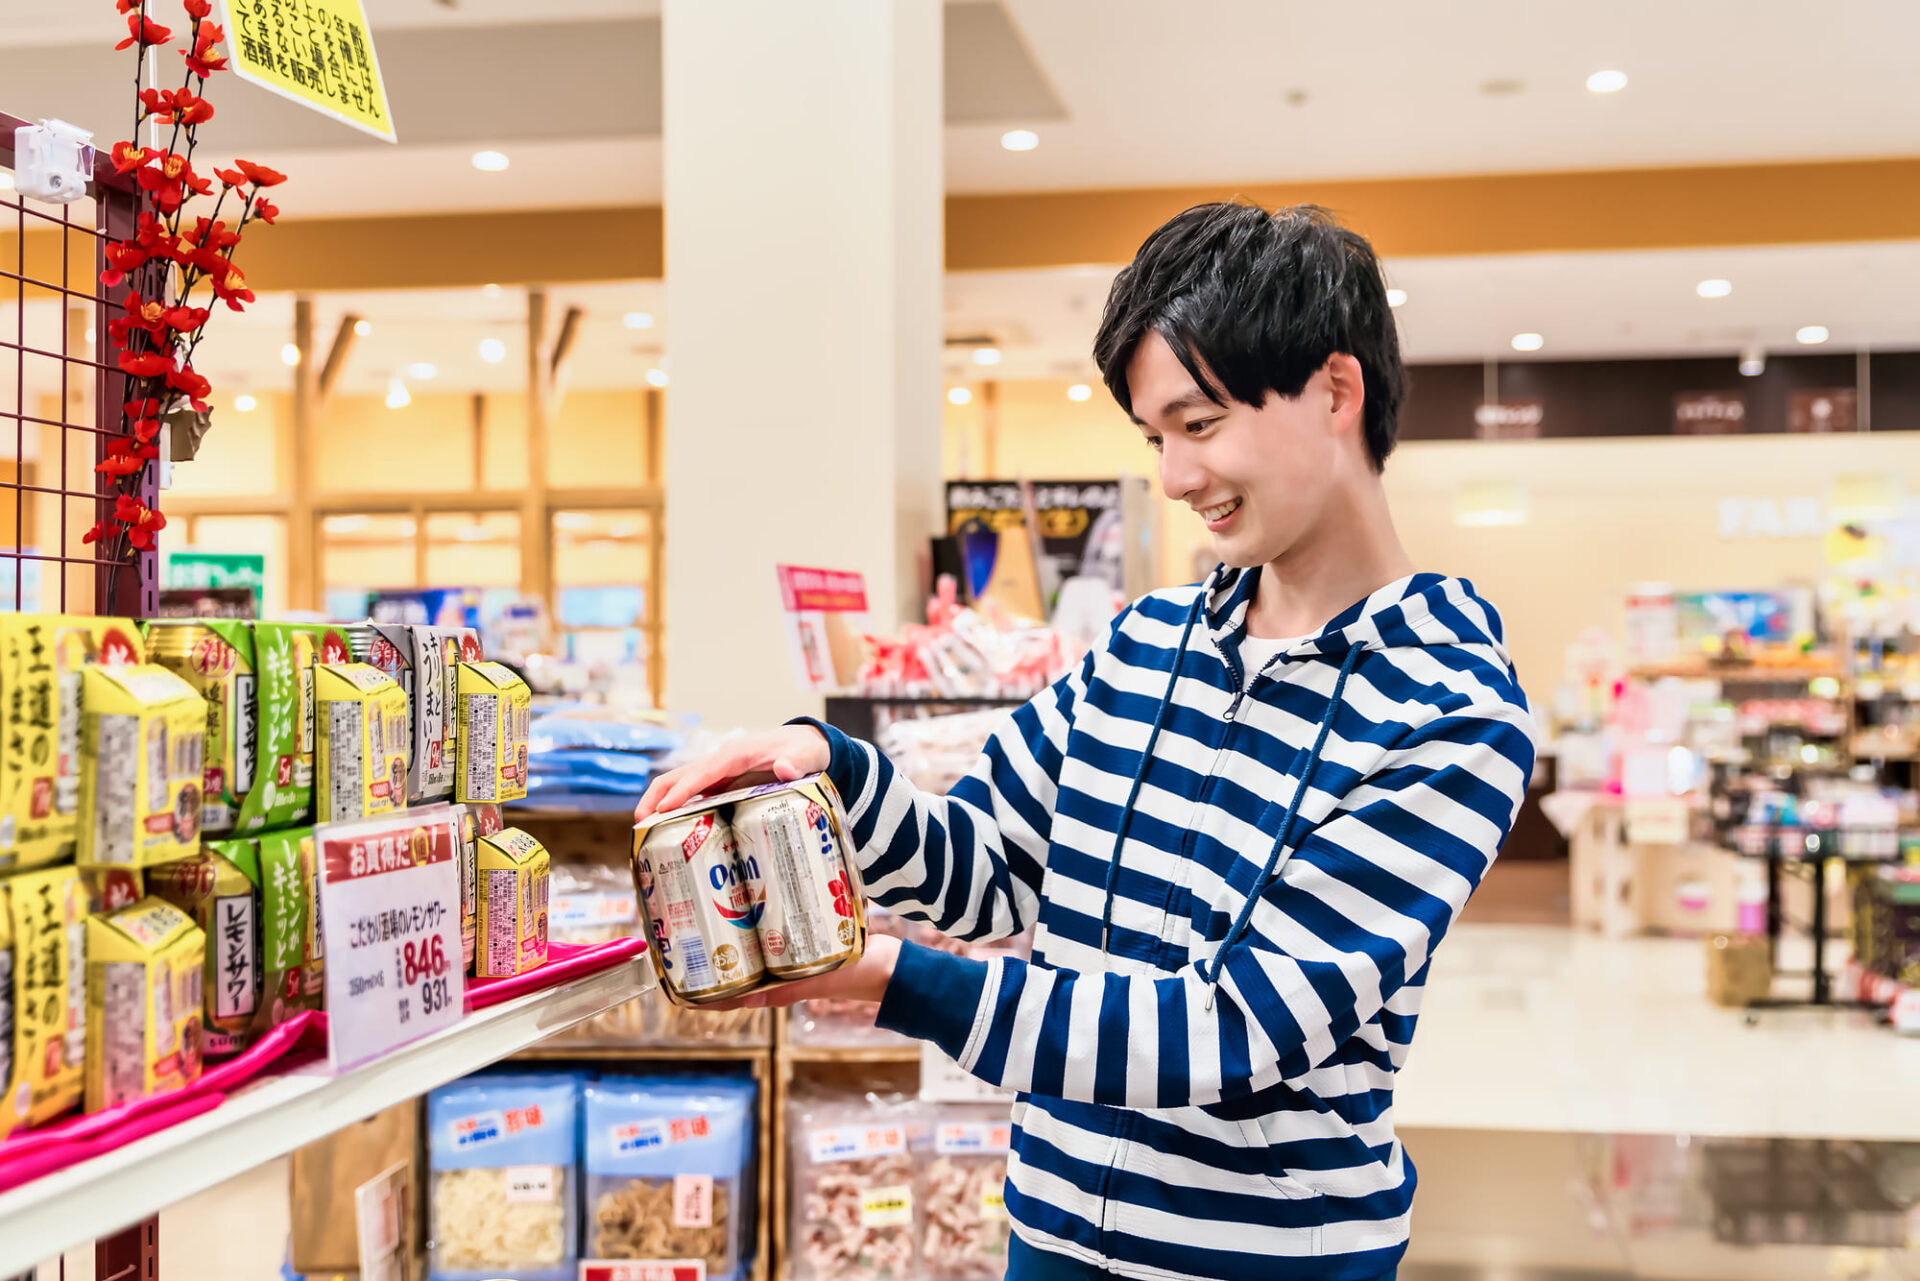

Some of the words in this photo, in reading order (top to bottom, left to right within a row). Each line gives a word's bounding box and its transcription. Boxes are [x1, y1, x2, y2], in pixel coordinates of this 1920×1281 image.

[236, 10, 374, 95] できない場合には
[240, 34, 380, 119] 酒類を販売しません
[267, 646, 281, 779] キュッと！
[276, 627, 293, 740] レモンが
[422, 642, 435, 760] うまい！
[430, 631, 441, 716] キリッと
[283, 839, 301, 952] レモンが
[349, 901, 447, 949] こだわり酒場のレモンサワー
[225, 903, 249, 1011] レモンサワー
